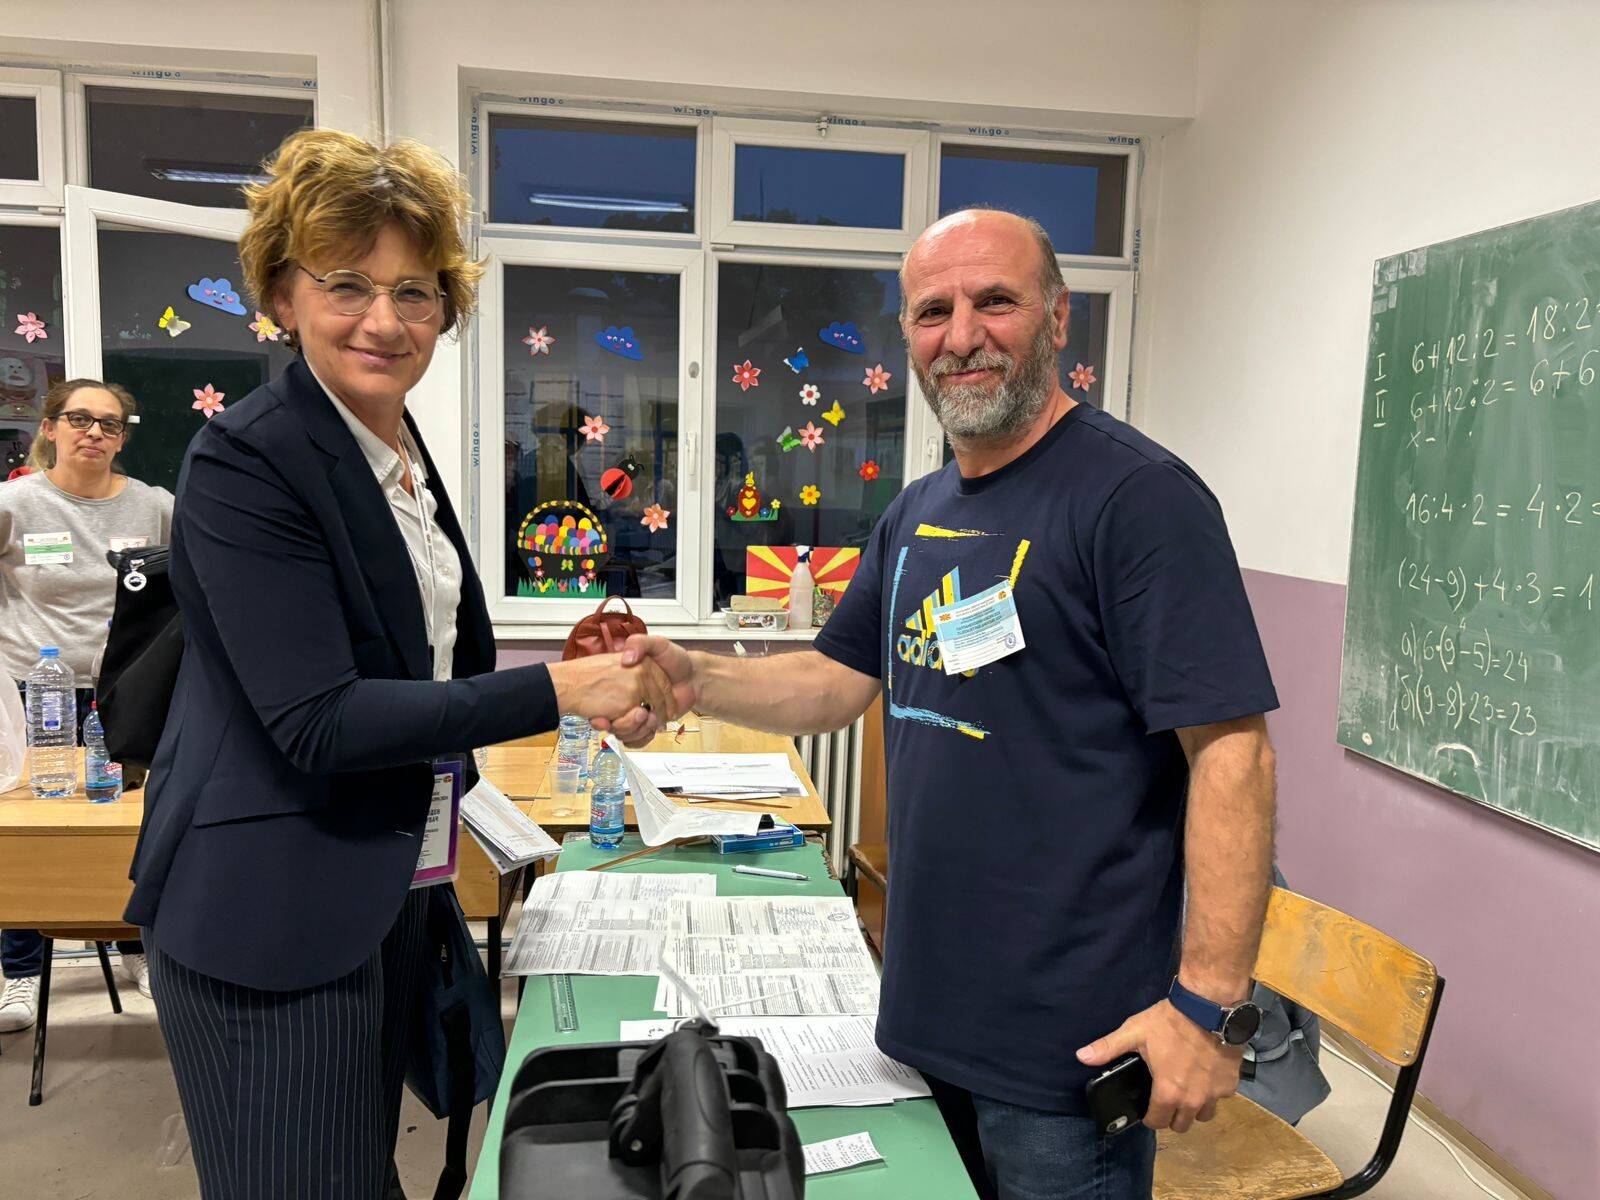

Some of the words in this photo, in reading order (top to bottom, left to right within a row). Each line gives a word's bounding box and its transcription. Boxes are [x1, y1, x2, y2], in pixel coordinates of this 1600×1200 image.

[519, 96, 555, 105] wingo
[471, 116, 479, 155] wingo
[1108, 135, 1141, 145] wingo
[1132, 229, 1141, 264] wingo
